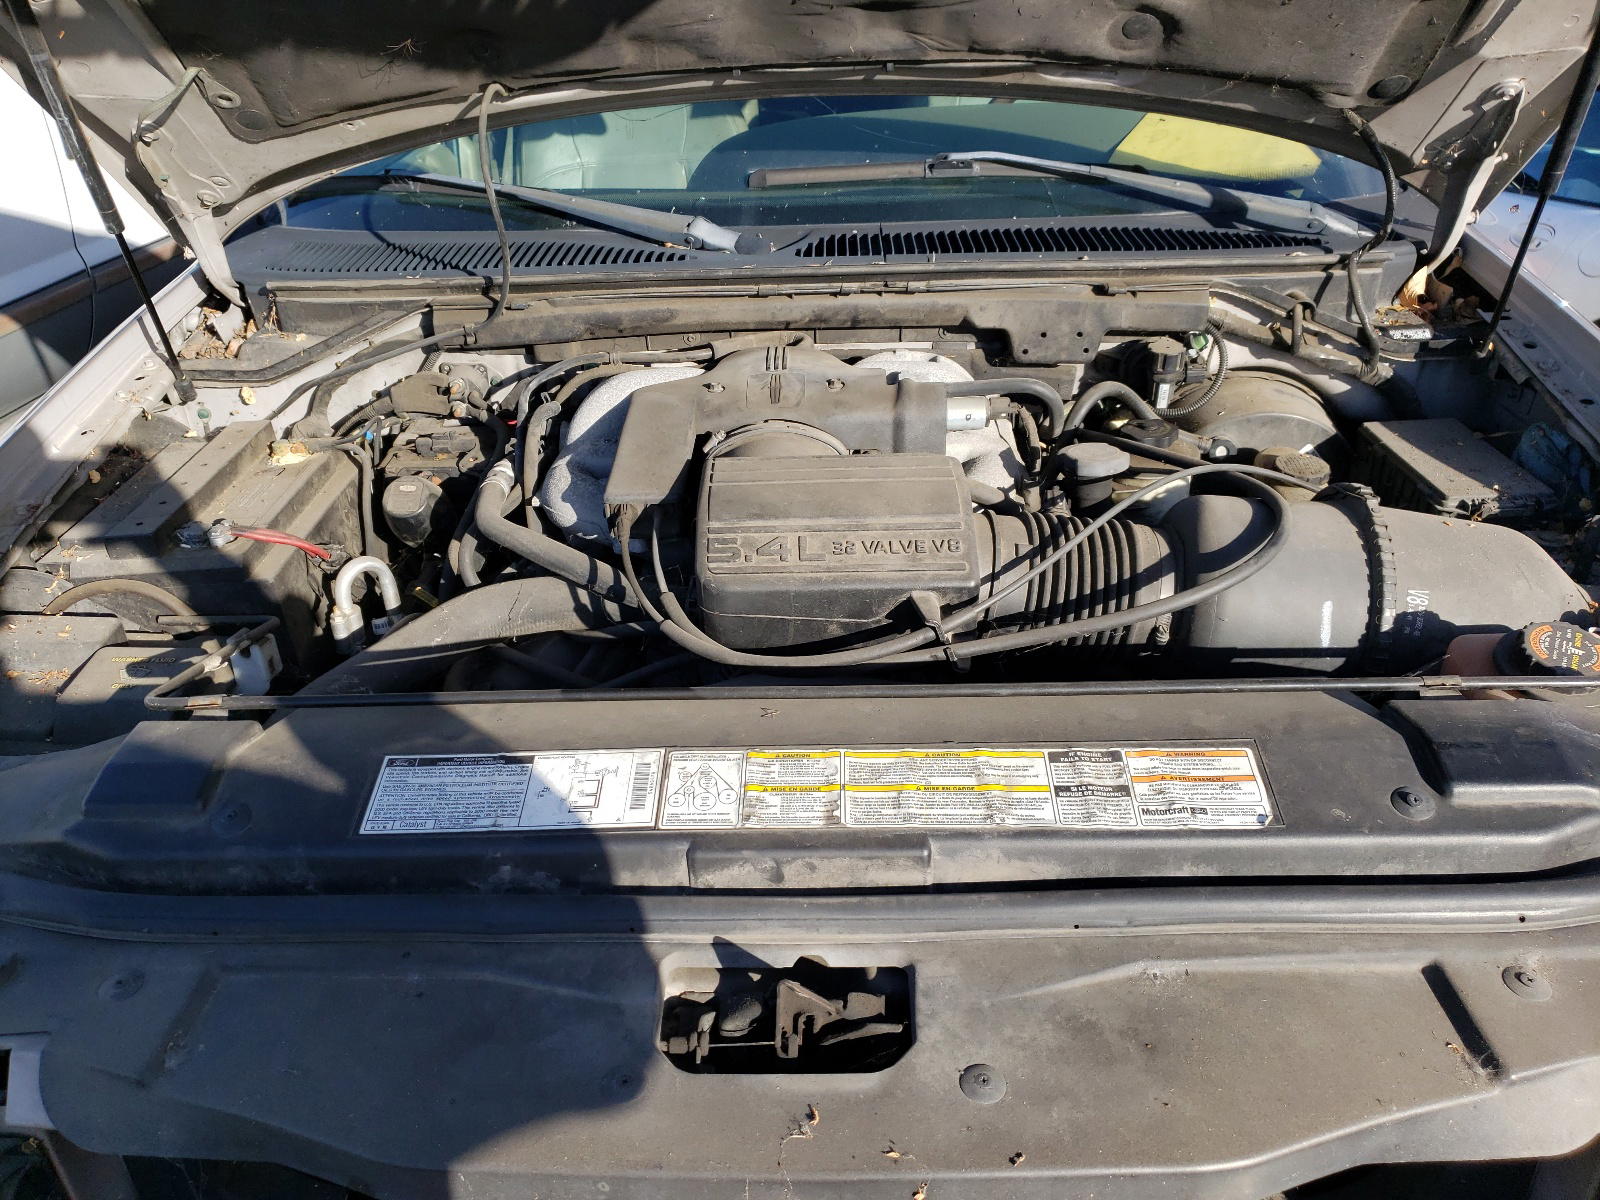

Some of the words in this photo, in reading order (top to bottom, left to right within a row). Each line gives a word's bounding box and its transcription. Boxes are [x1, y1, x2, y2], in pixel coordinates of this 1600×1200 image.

[706, 535, 827, 564] 5.4L
[832, 540, 857, 556] 32
[861, 539, 928, 555] VALVE
[932, 538, 962, 554] V8
[1141, 806, 1189, 816] Motorcraft
[399, 820, 427, 829] Catalyst
